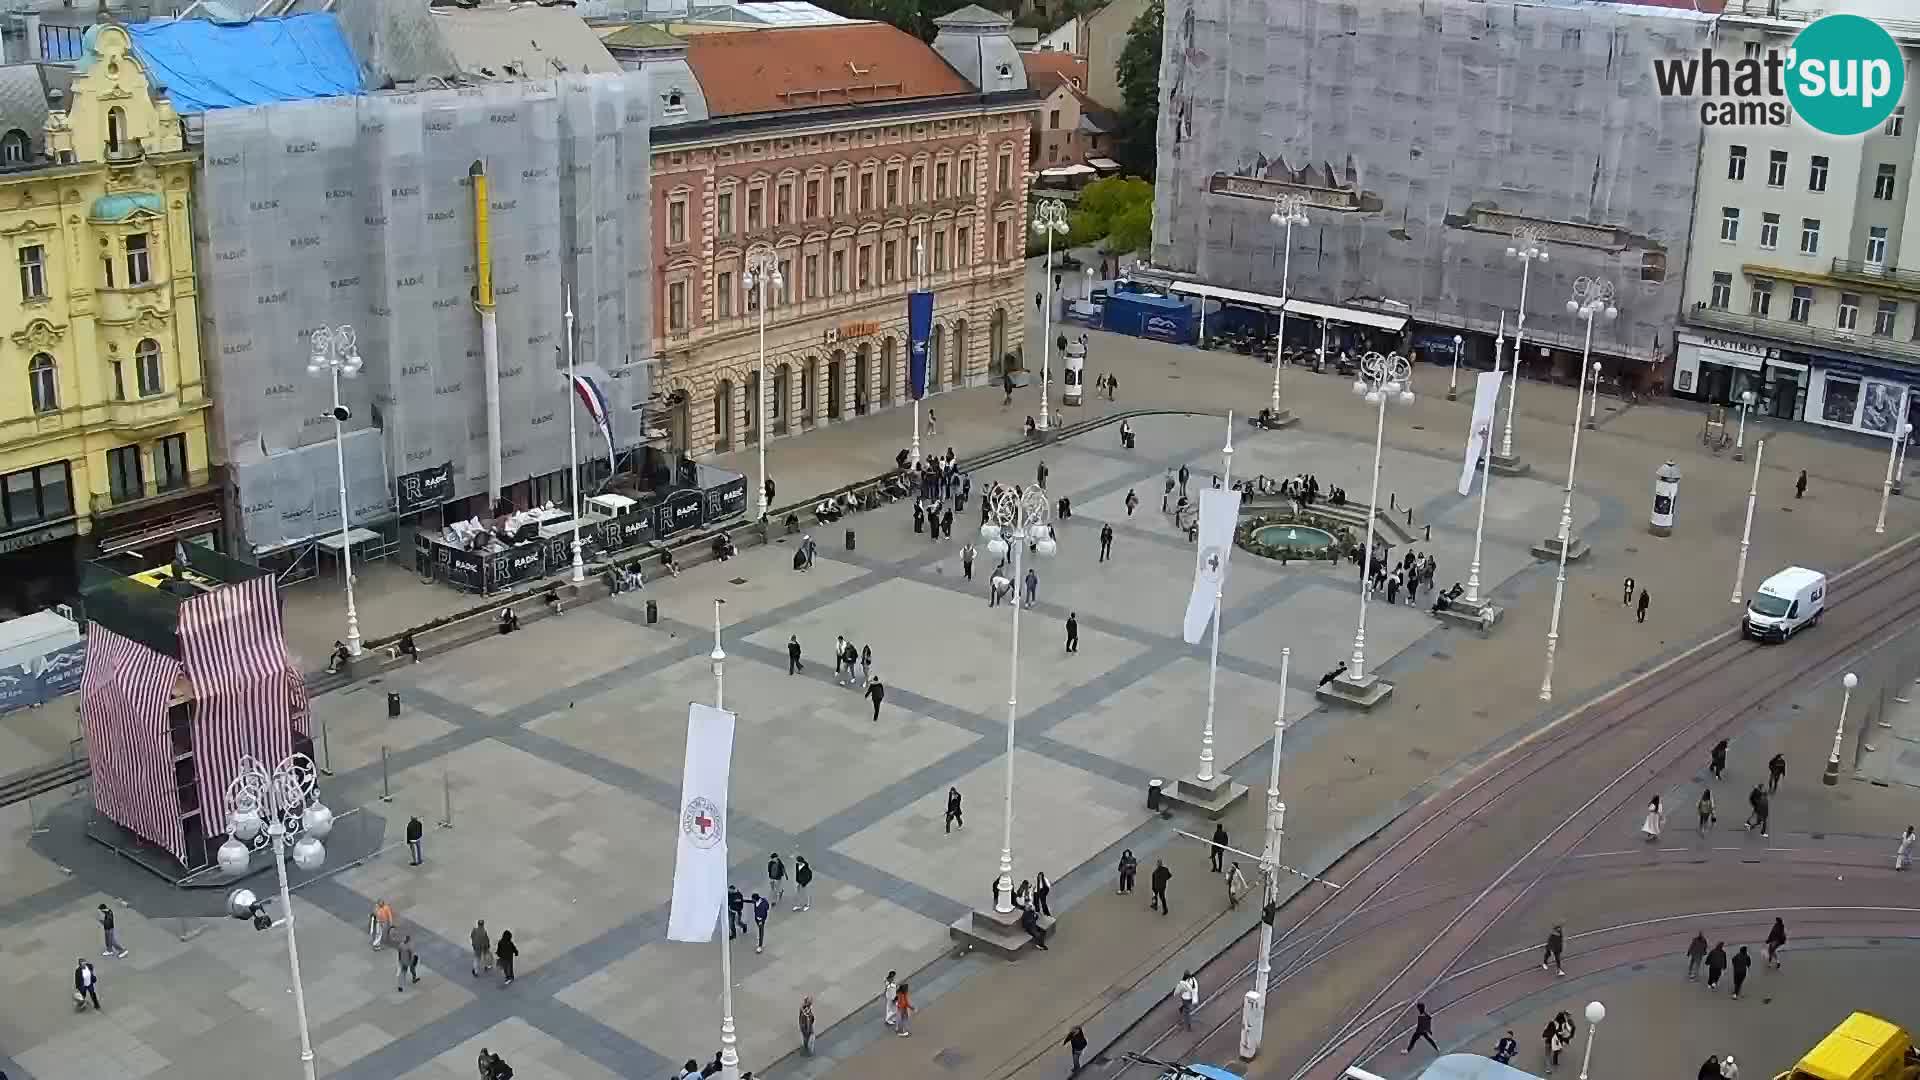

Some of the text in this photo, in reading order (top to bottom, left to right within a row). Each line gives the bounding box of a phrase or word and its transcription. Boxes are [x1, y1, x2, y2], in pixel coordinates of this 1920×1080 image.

[286, 142, 319, 153] RADIĆ
[1703, 335, 1761, 354] MARTIMEX
[407, 472, 447, 500] R RADIĆ
[709, 486, 744, 514] R RADIĆ
[660, 502, 698, 531] R RADIĆ
[607, 518, 648, 547] R RADIĆ
[552, 534, 593, 565] R RDIĆ
[455, 560, 478, 573] RADIĆ
[495, 552, 538, 582] R RADIĆ
